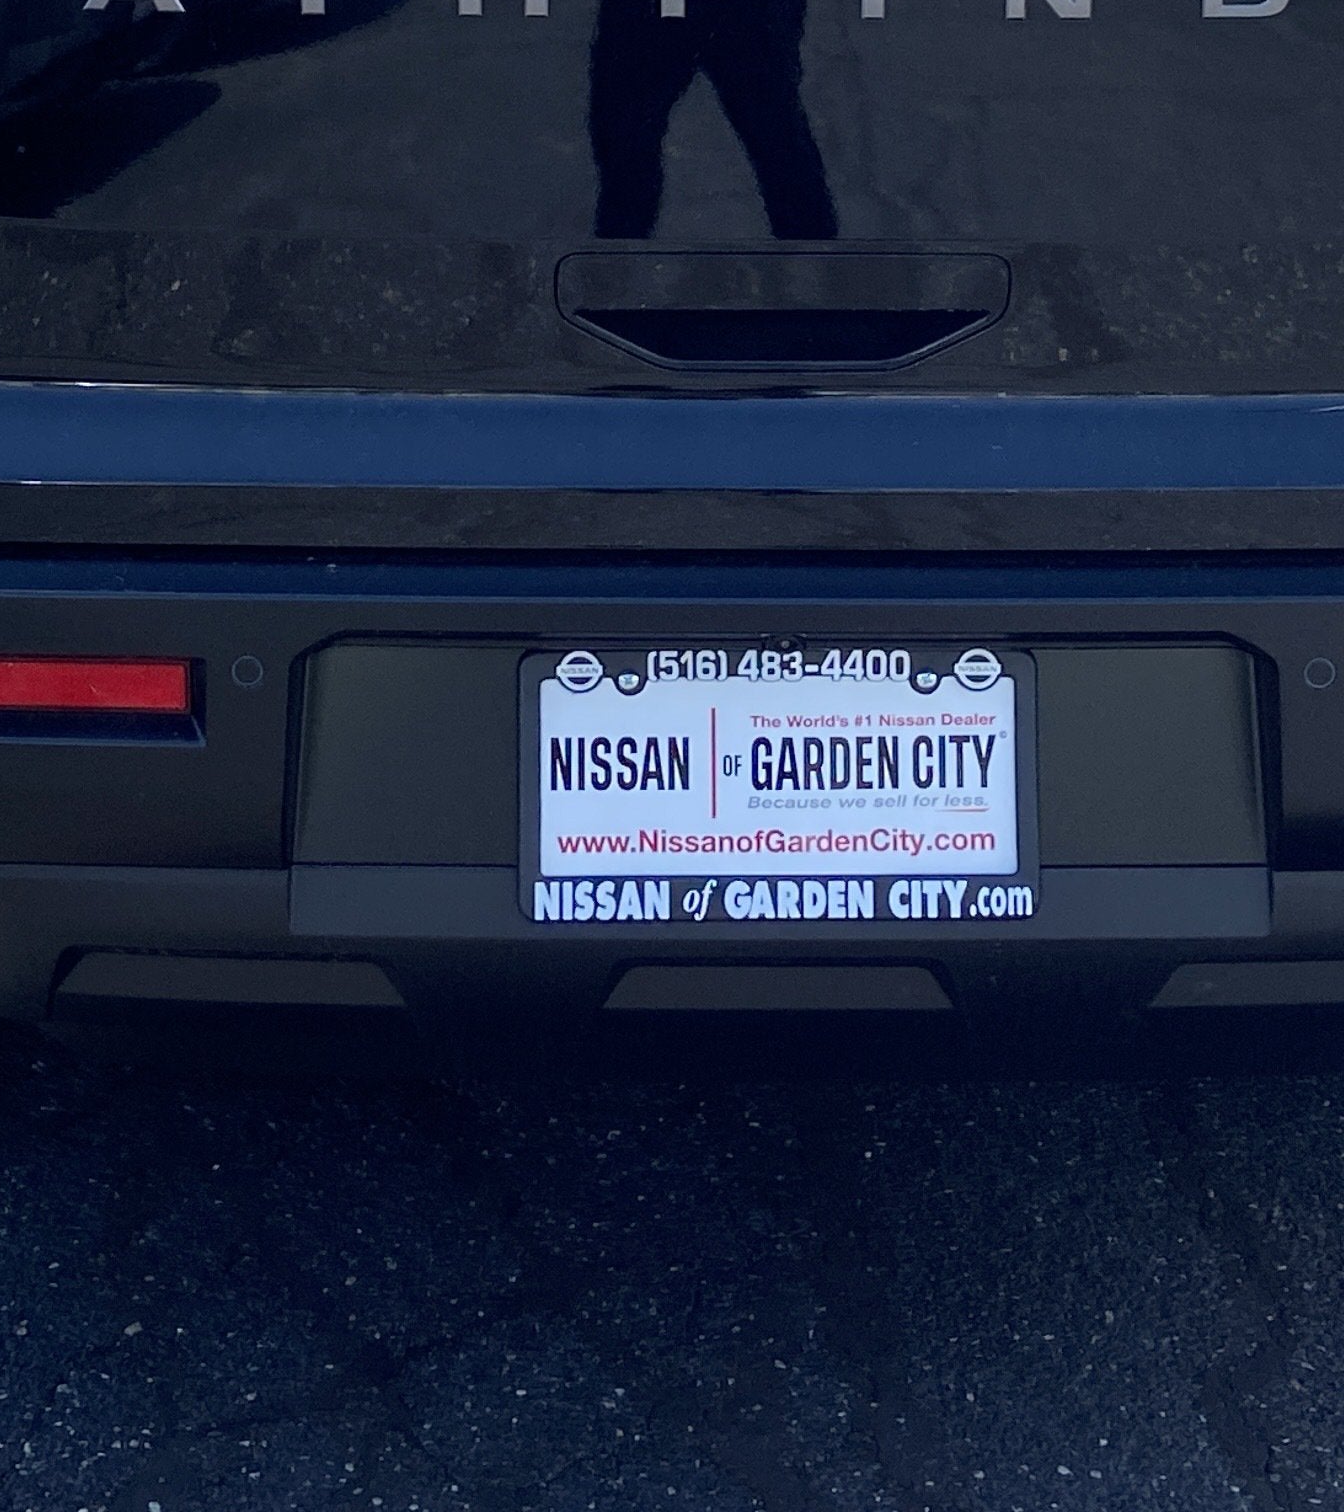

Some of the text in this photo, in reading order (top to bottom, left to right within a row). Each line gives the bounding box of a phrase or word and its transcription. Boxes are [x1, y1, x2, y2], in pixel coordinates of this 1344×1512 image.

[647, 648, 912, 683] (516) 483-4400
[750, 713, 996, 728] The World's #1 Nissan Dealer
[550, 734, 996, 791] NISSAN OF GARDEN CITY
[747, 794, 989, 809] Because we sell for less.
[557, 828, 996, 856] www.NissanofGardenCity.com
[534, 879, 1033, 921] NISSAN of GARDEN CITY.com
